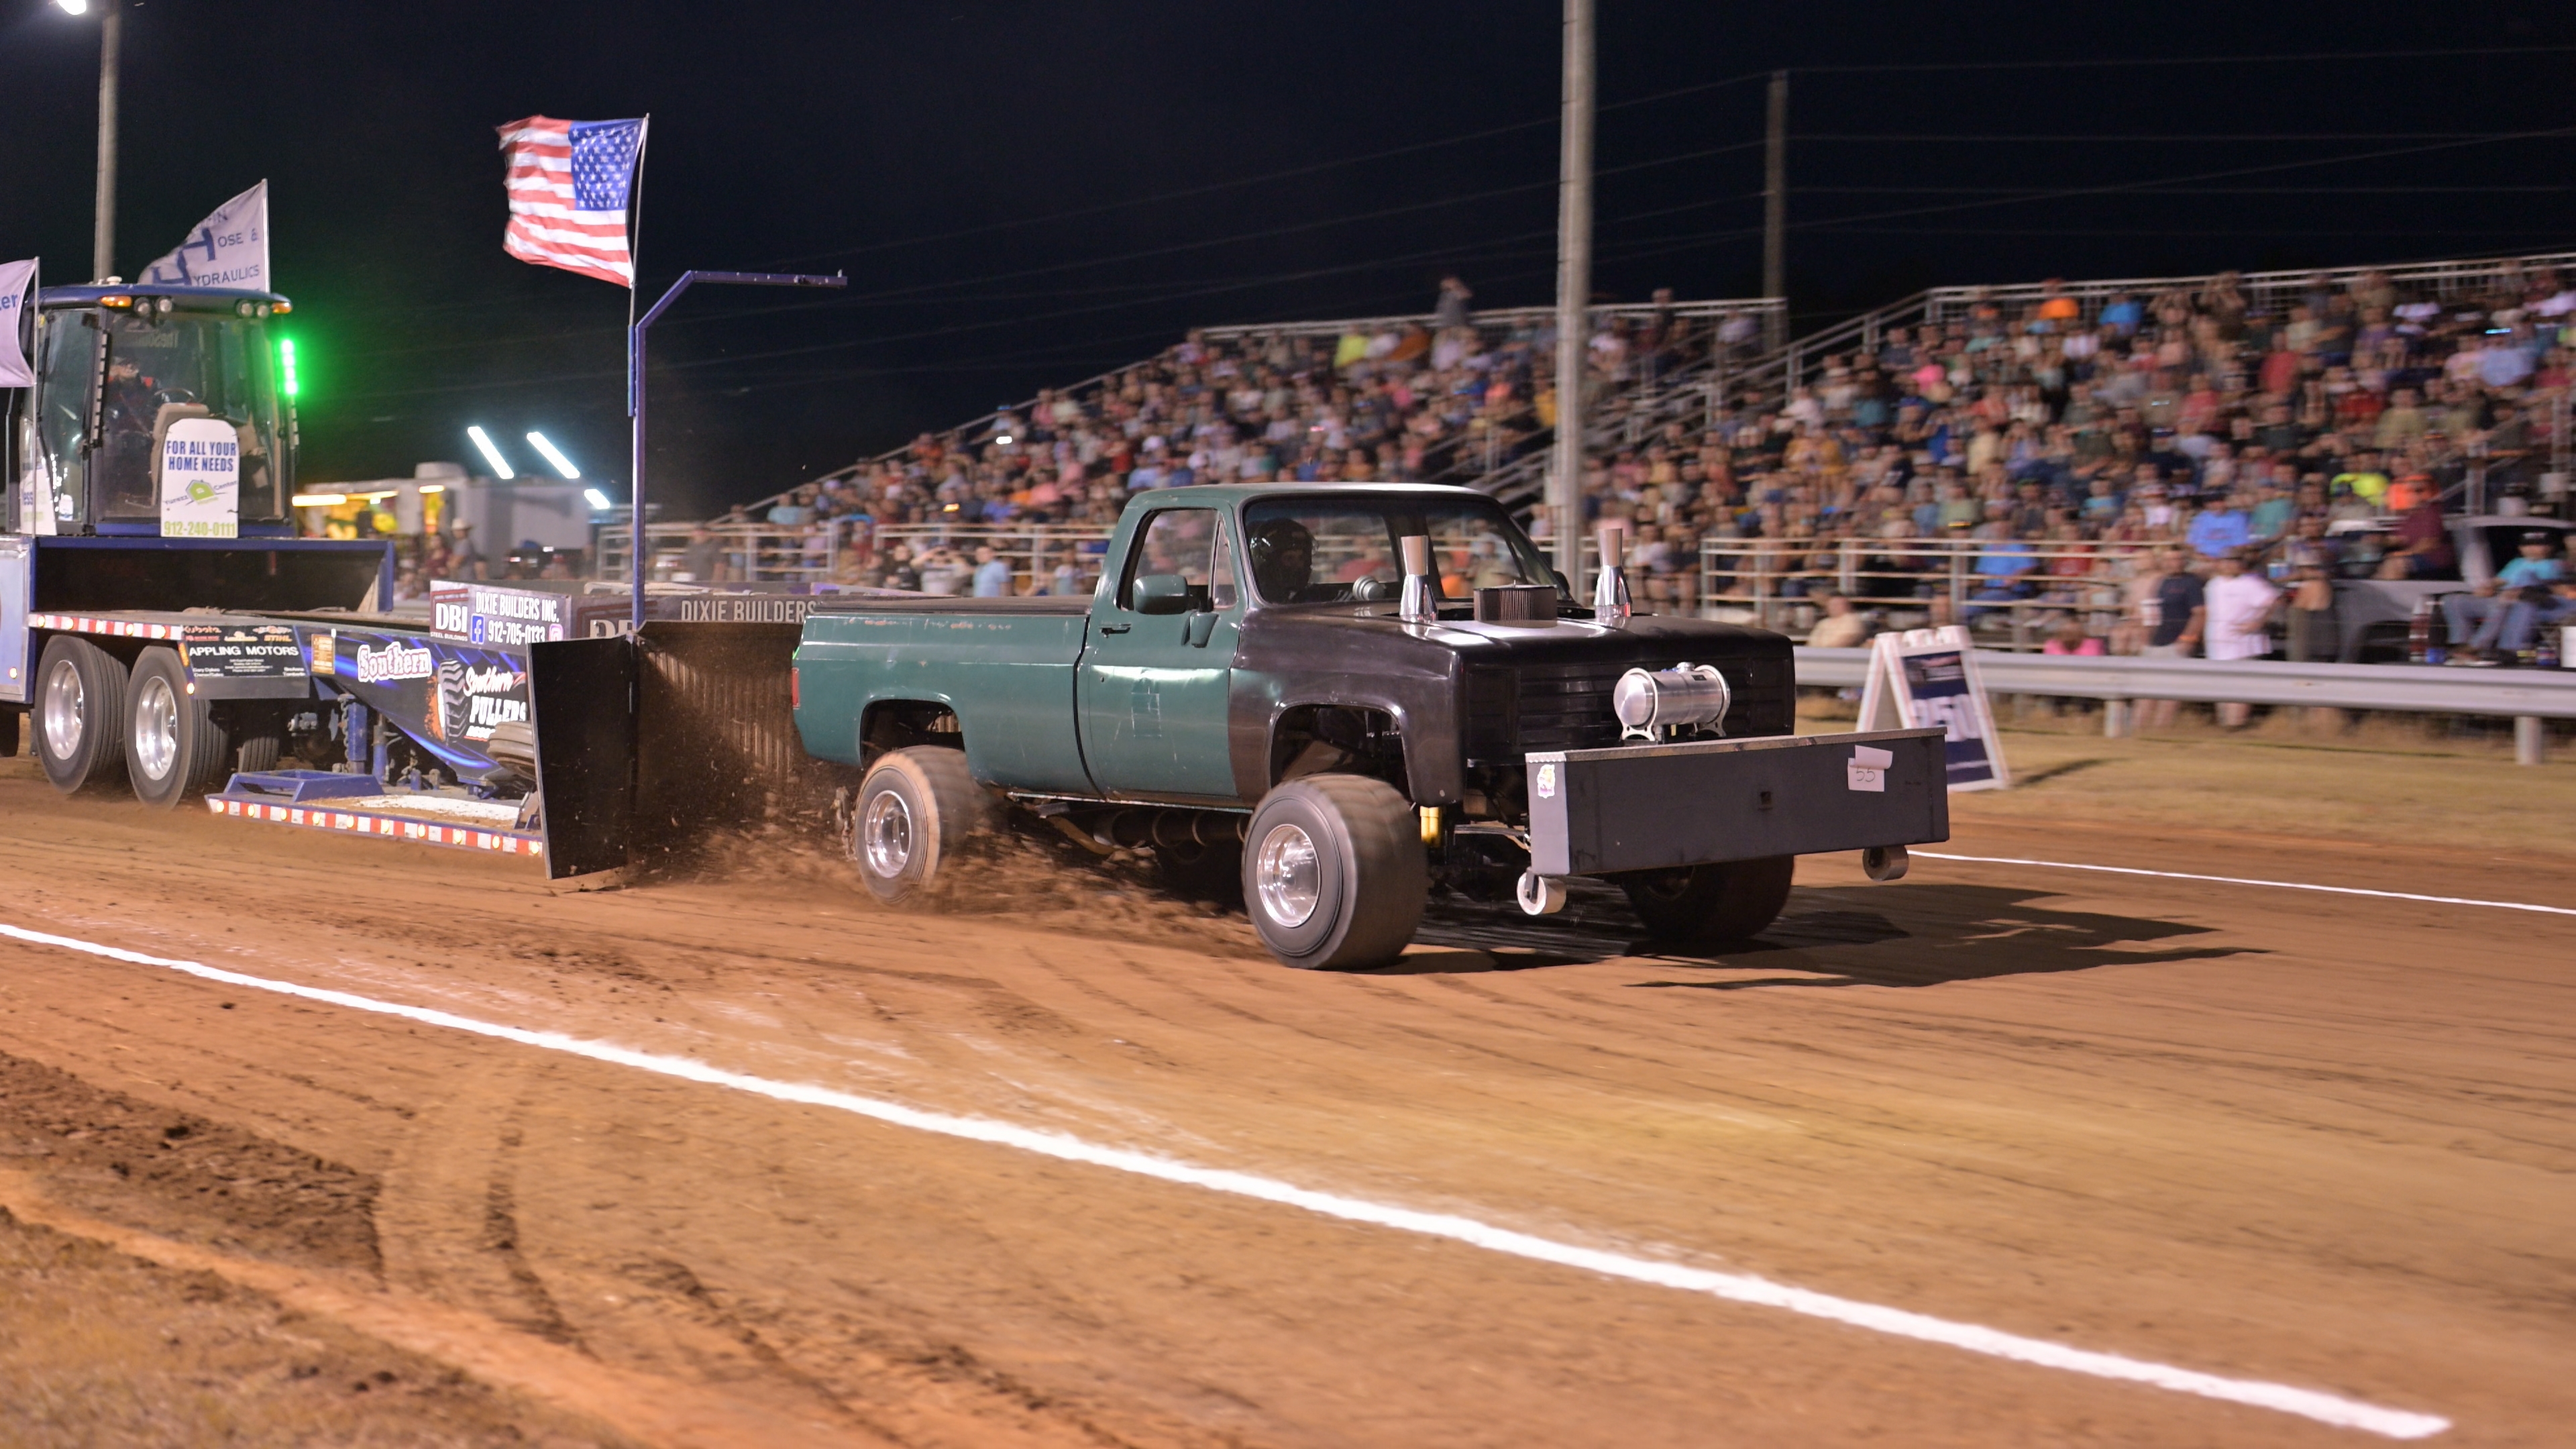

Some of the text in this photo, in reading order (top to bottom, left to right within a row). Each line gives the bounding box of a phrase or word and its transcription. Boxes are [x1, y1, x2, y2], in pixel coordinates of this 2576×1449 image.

[166, 440, 237, 456] FOR ALL YOUR
[168, 457, 233, 472] HOME NEEDS
[164, 521, 235, 536] 912-240-0111
[476, 591, 559, 623] DIXIE BUILDERS INC.
[682, 600, 727, 622] DIXIE
[435, 603, 468, 633] DBI
[189, 645, 242, 657] APPLING
[246, 645, 300, 656] MOTORS
[359, 643, 431, 680] Southern
[463, 665, 513, 696] Southern
[1856, 765, 1876, 783] 55
